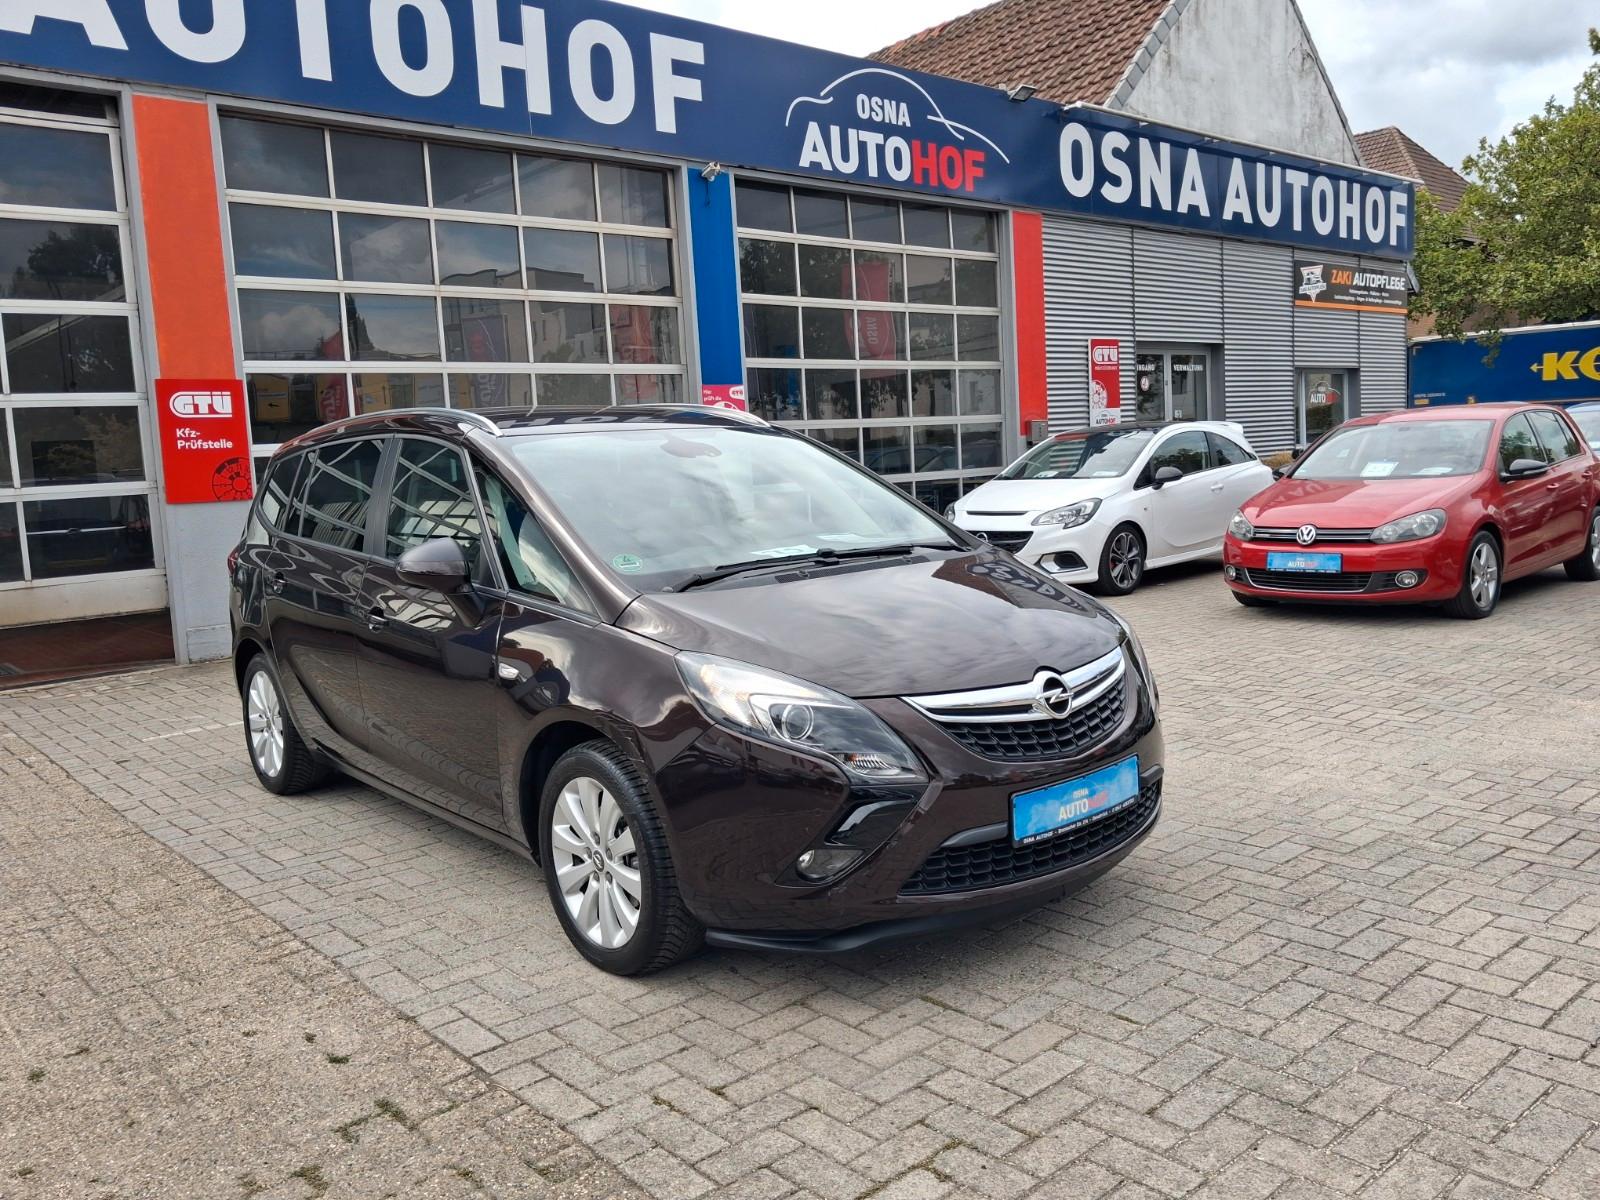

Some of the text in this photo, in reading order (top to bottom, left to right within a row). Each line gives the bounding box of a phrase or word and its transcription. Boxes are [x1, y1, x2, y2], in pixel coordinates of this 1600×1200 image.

[856, 93, 911, 128] OSNA
[799, 121, 986, 193] AUTOHOF
[1059, 122, 1408, 246] OSNA AUTOHOF
[1331, 269, 1406, 291] ZAKI AUTOPFLEGE
[176, 428, 201, 438] Kfz-
[177, 439, 233, 449] Prüfstelle
